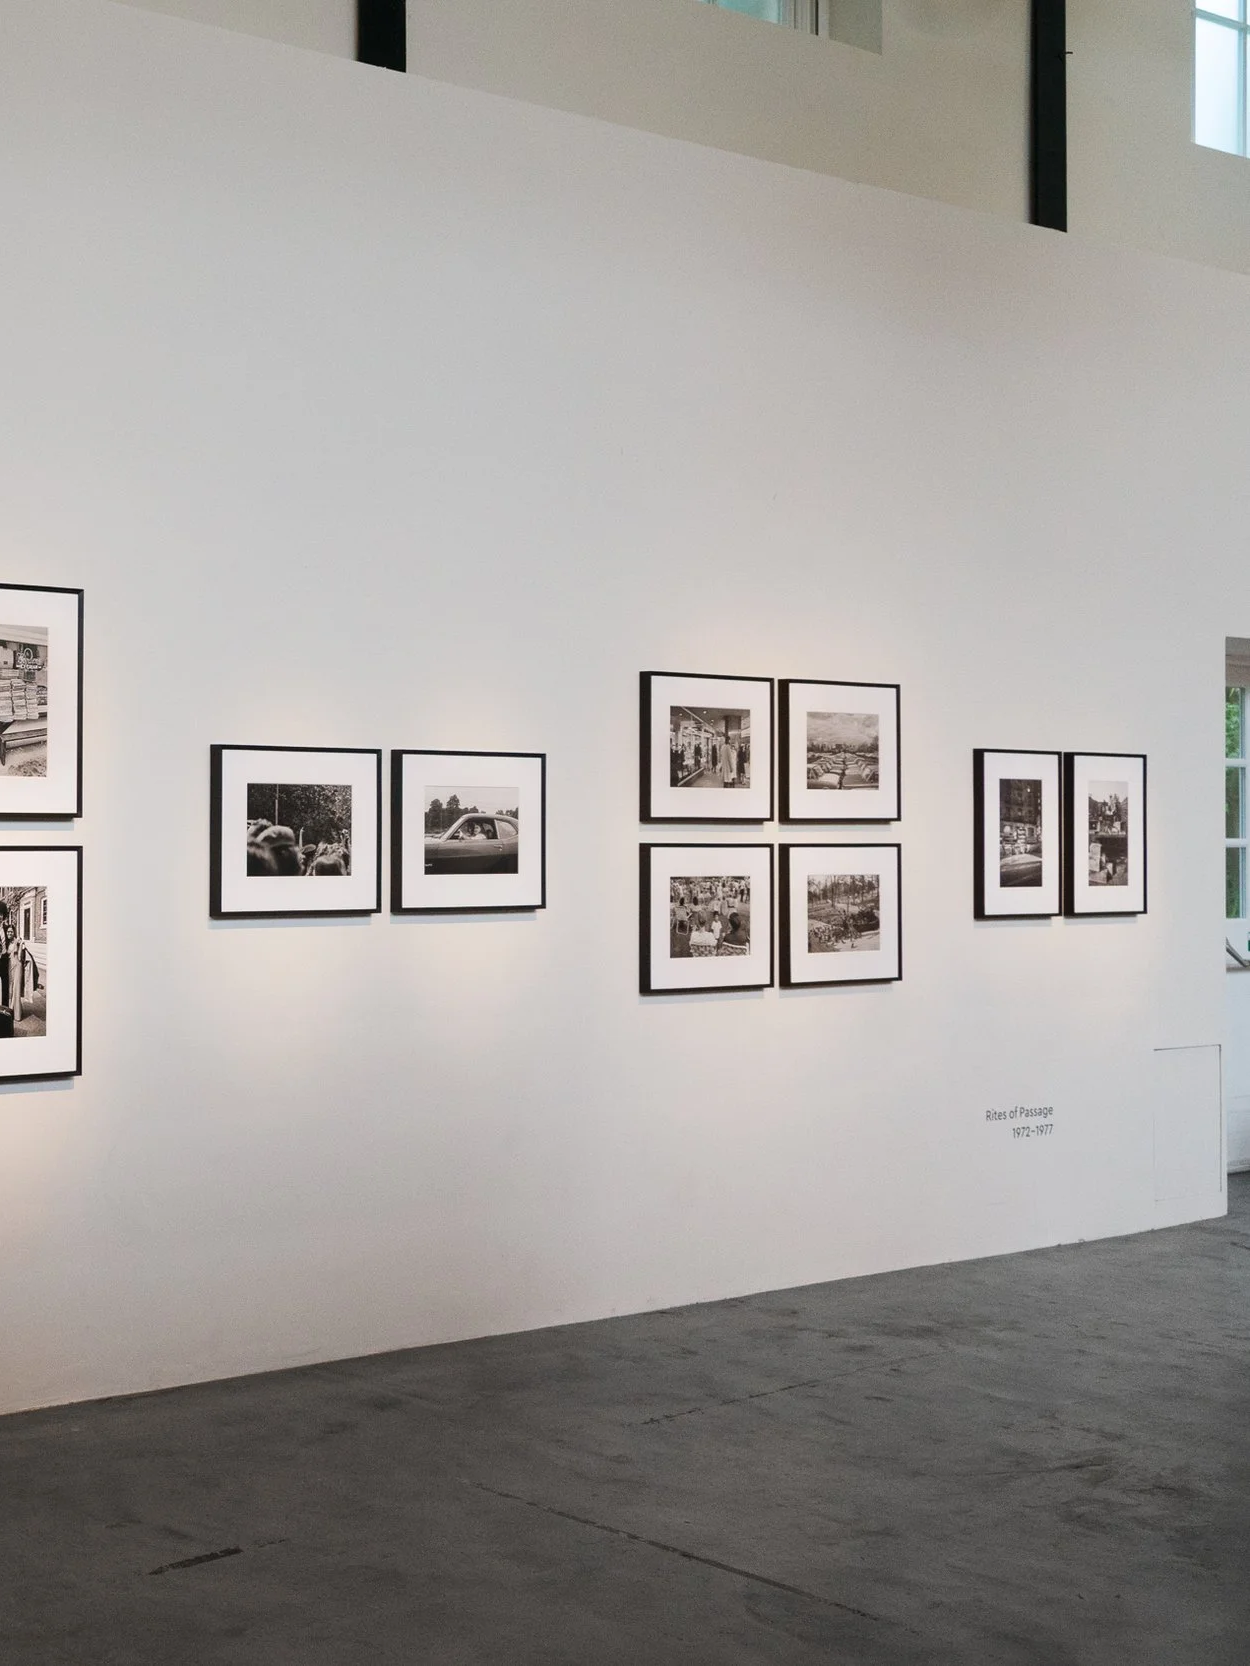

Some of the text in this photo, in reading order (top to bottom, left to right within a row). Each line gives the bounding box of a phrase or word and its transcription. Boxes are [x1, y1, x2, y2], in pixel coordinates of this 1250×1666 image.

[985, 1106, 1054, 1121] Rites of Passage
